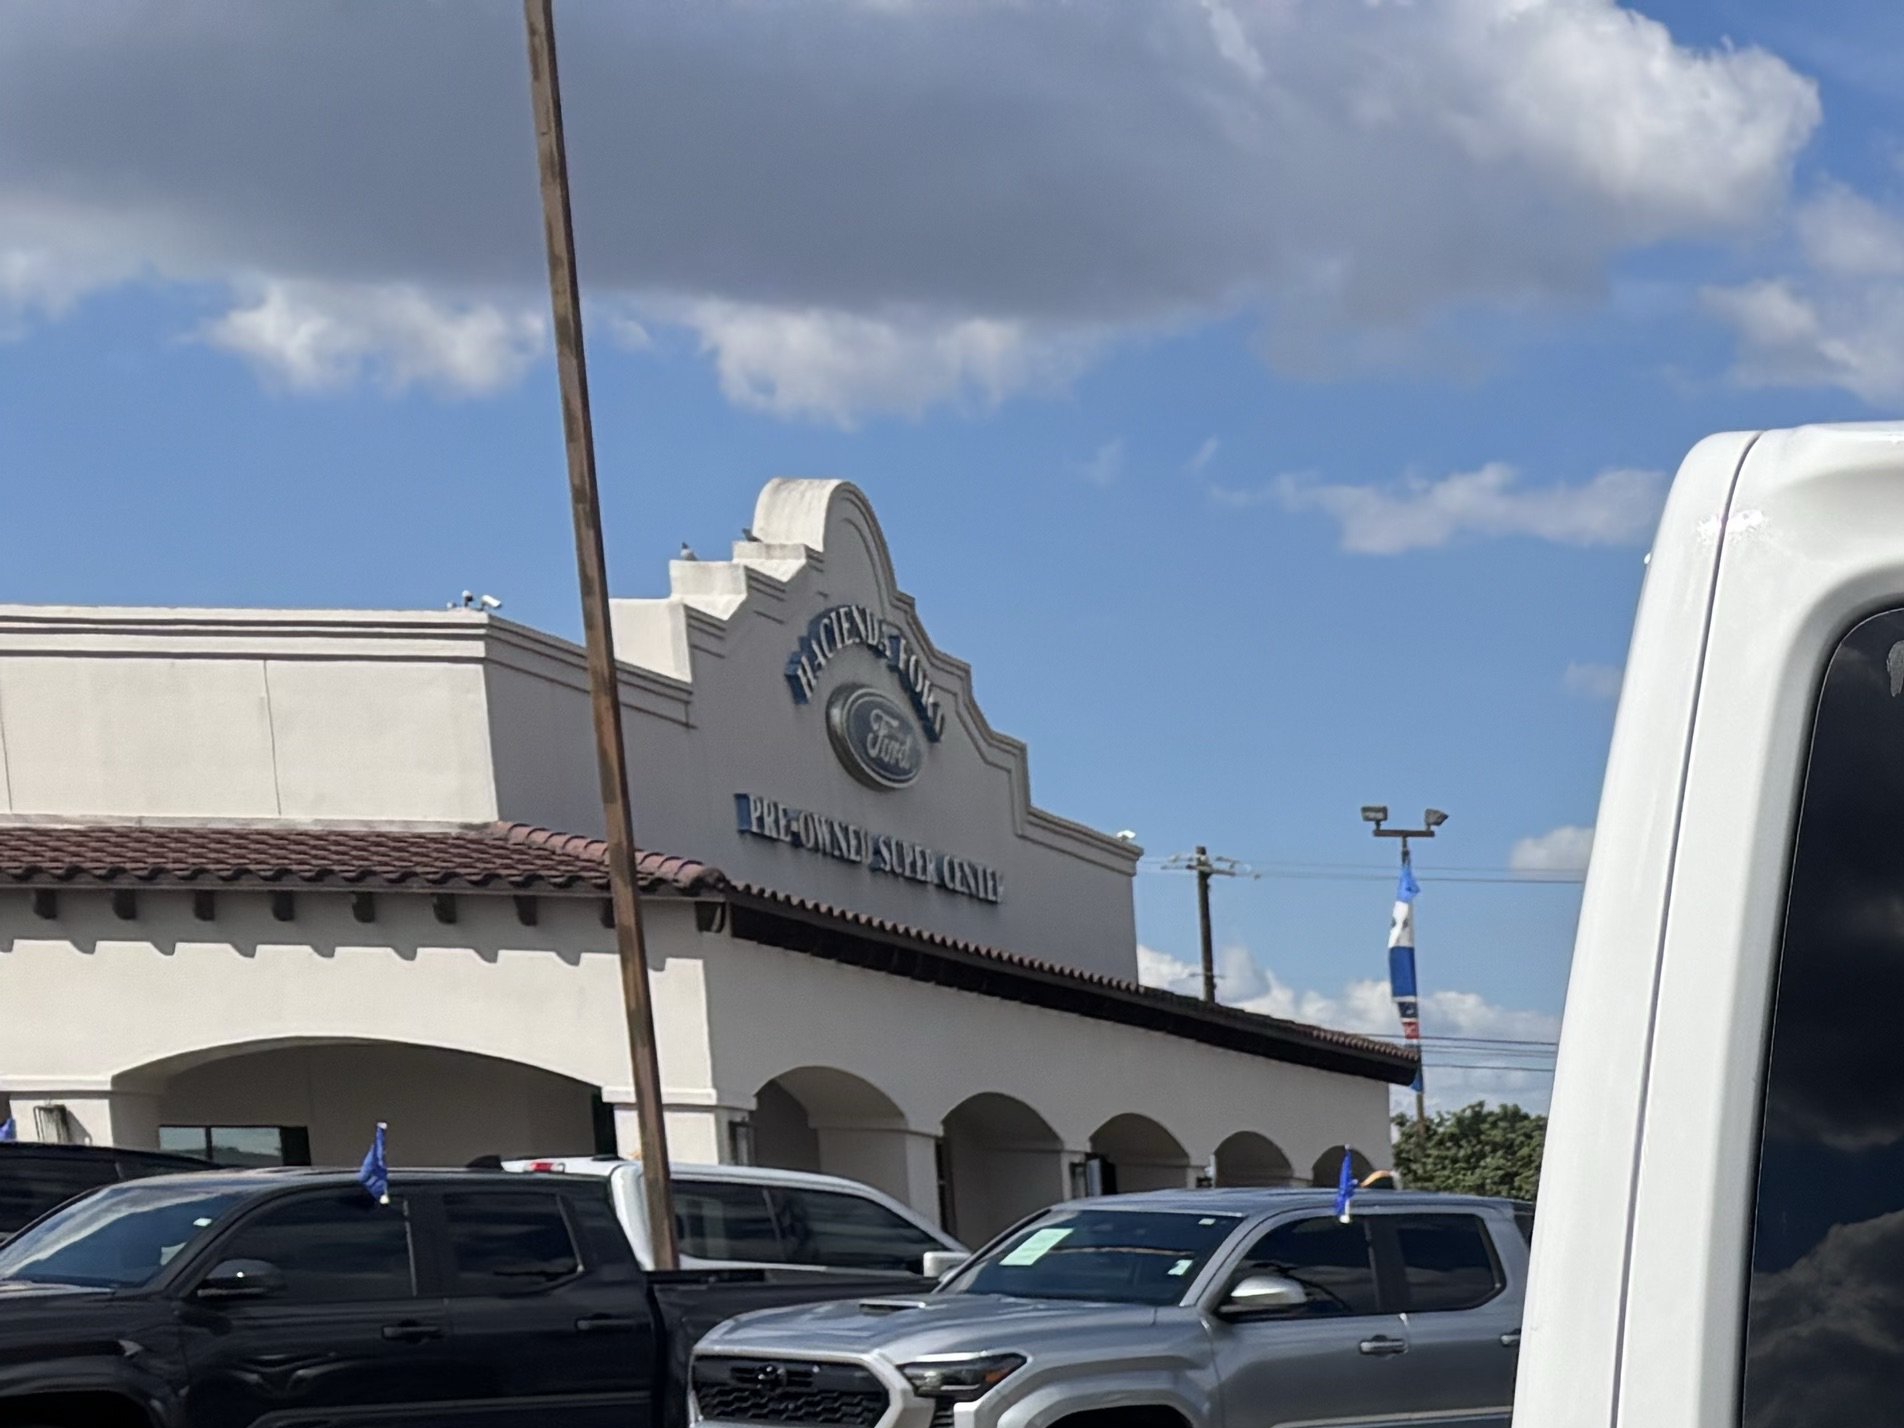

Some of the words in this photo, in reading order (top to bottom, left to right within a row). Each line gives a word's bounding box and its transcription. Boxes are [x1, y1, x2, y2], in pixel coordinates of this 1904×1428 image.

[790, 604, 892, 702] HACIENDA
[866, 708, 912, 770] Ford
[748, 796, 872, 866] PRE-OWNED
[879, 833, 938, 883] SUPER
